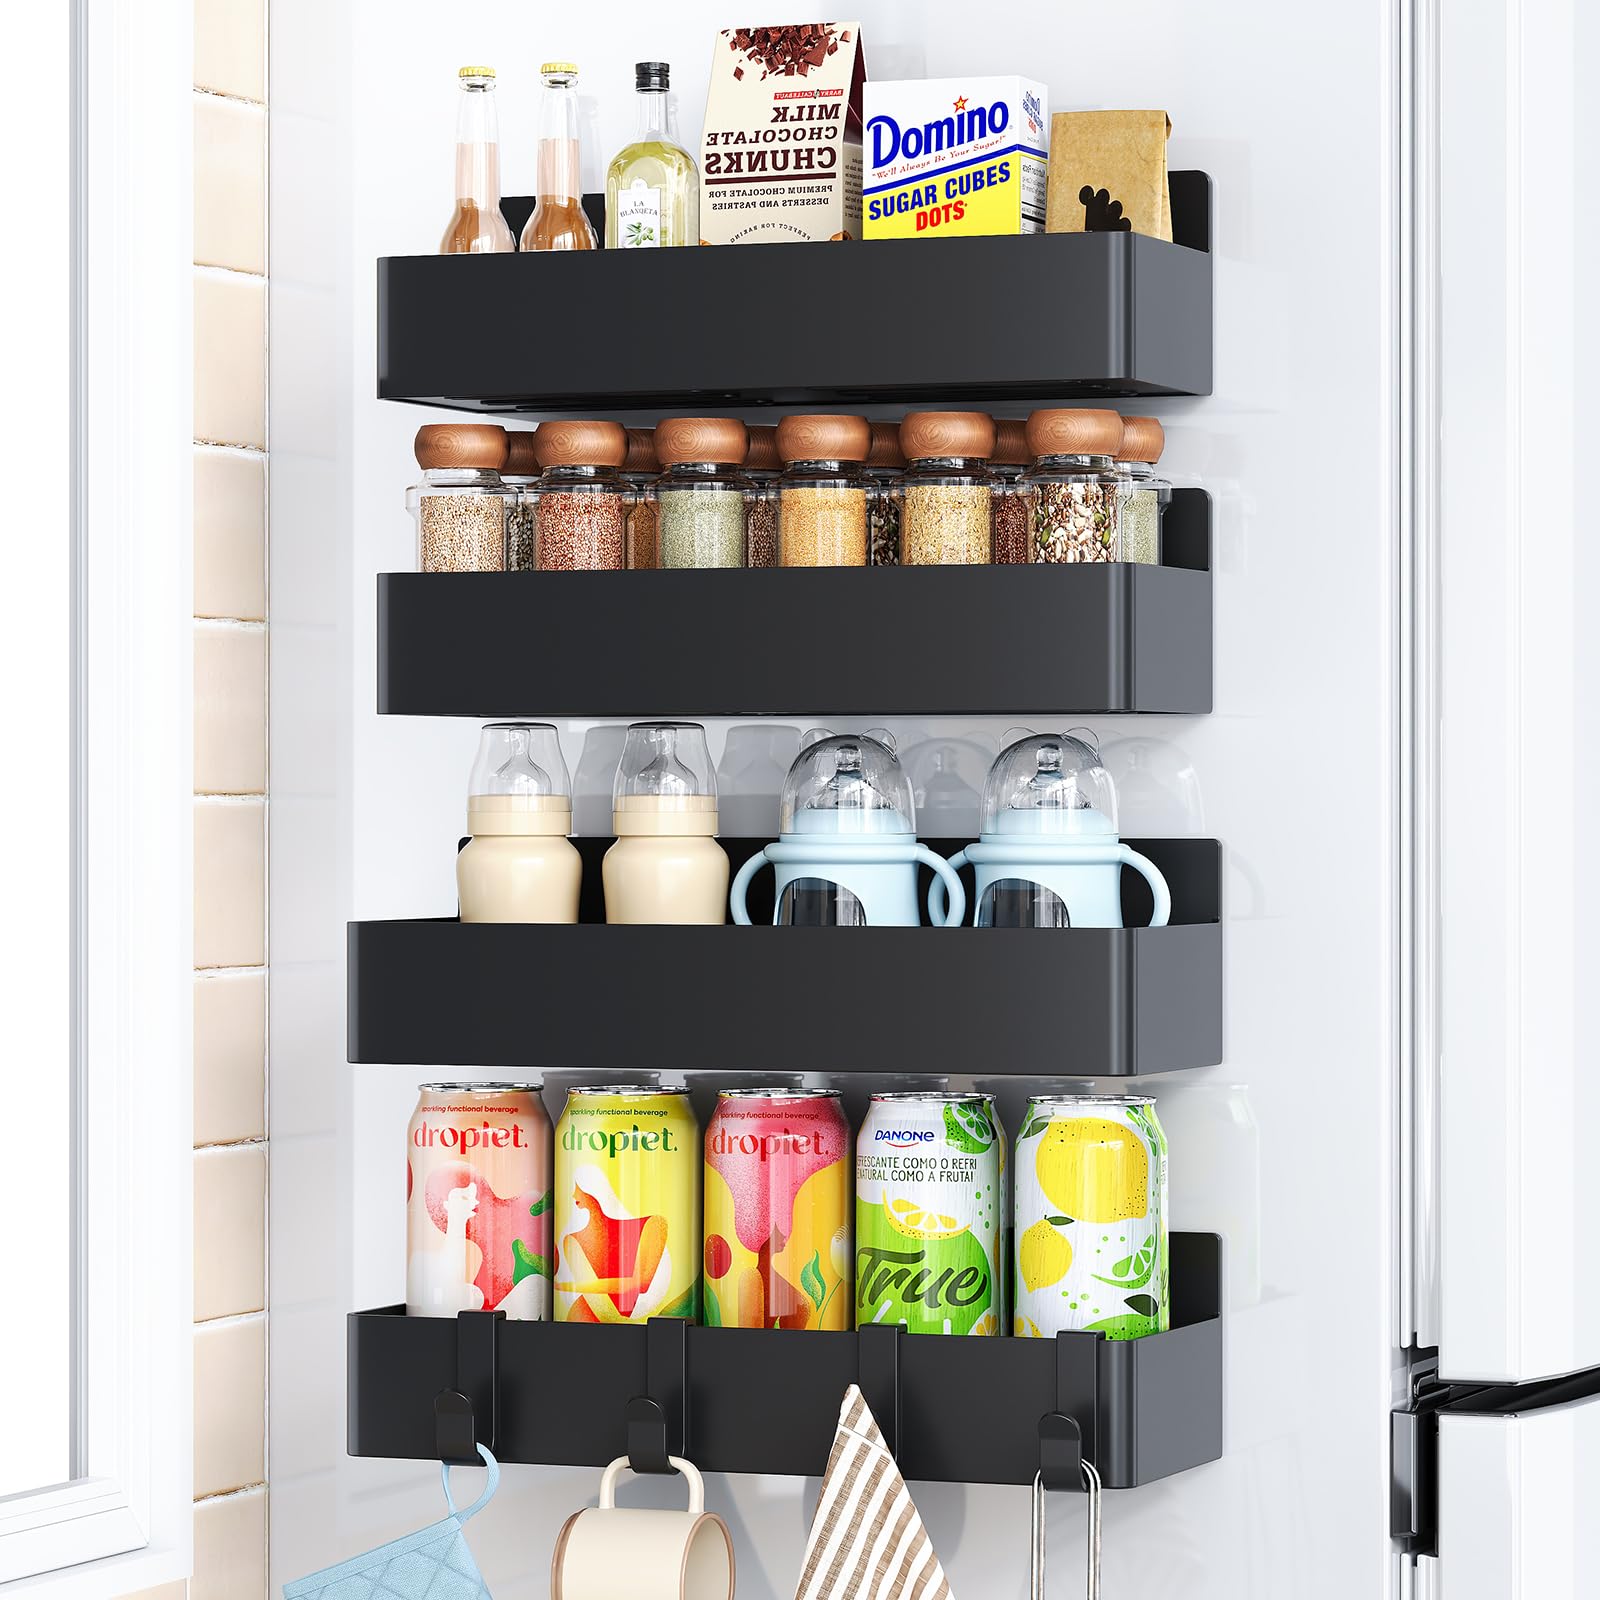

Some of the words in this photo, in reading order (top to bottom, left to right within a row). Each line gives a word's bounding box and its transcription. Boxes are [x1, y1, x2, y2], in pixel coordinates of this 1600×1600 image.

[866, 101, 1009, 169] Domino
[899, 160, 931, 174] Always
[934, 155, 946, 163] Be
[949, 149, 970, 158] Your
[868, 184, 937, 221] SUGAR
[945, 161, 1011, 200] CUBES
[916, 200, 965, 232] DOTS
[447, 1105, 483, 1113] functional
[484, 1106, 519, 1114] beverage
[596, 1108, 632, 1116] functional
[633, 1109, 668, 1117] beverage
[784, 1112, 819, 1120] beverage
[903, 1157, 937, 1170] COMO
[940, 1158, 949, 1170] O
[952, 1158, 977, 1170] REFRI
[891, 1169, 924, 1182] COMO
[928, 1170, 936, 1182] A
[940, 1170, 974, 1182] FRUTA!
[857, 1247, 988, 1309] True
